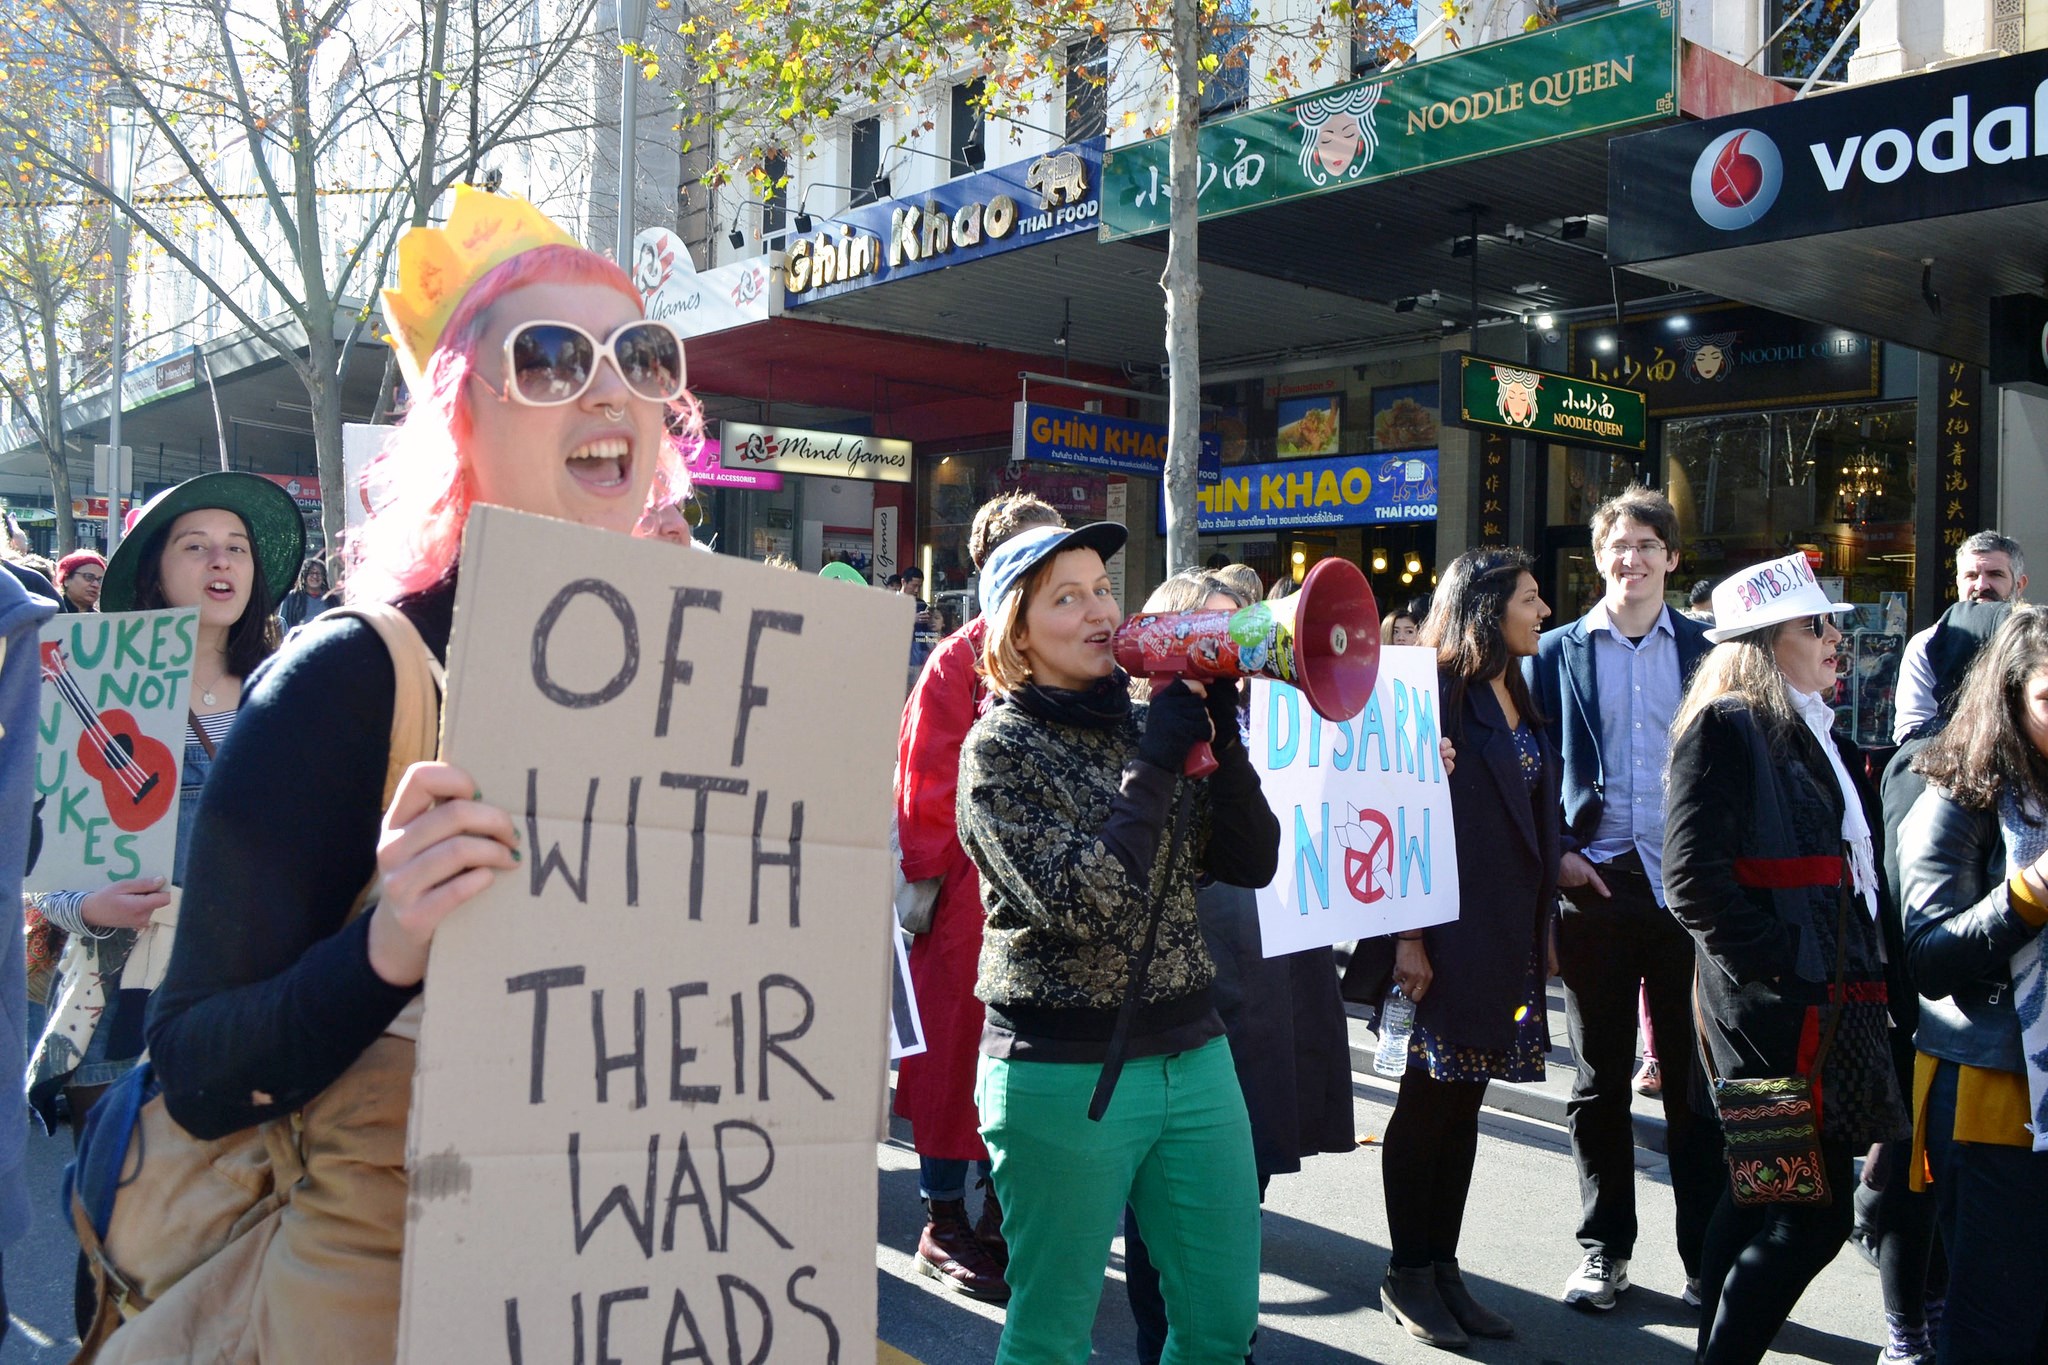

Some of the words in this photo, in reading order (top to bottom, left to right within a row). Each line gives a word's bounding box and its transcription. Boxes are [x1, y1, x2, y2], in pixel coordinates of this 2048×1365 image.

[1406, 81, 1524, 136] NOODLE
[1528, 55, 1636, 105] QUEEN
[1018, 211, 1053, 236] THAI
[1056, 200, 1099, 226] FOOD
[785, 224, 878, 293] Ghin
[889, 194, 1018, 267] Khao
[1740, 341, 1806, 366] NOODLE
[1811, 337, 1868, 359] QUEEN
[1553, 412, 1593, 432] NOODLE
[1593, 420, 1623, 437] QUEEN
[716, 473, 757, 484] ACCESSORIES
[777, 436, 842, 460] Mind
[846, 440, 906, 476] Games
[1260, 467, 1372, 510] KHAO
[1403, 503, 1438, 518] FOOD
[71, 614, 198, 671] UKES
[97, 669, 189, 710] NOT
[530, 577, 804, 766] OFF
[1267, 678, 1441, 784] DISARM
[526, 768, 804, 928] WITH
[506, 965, 835, 1109] THEIR
[568, 1119, 796, 1260] WAR
